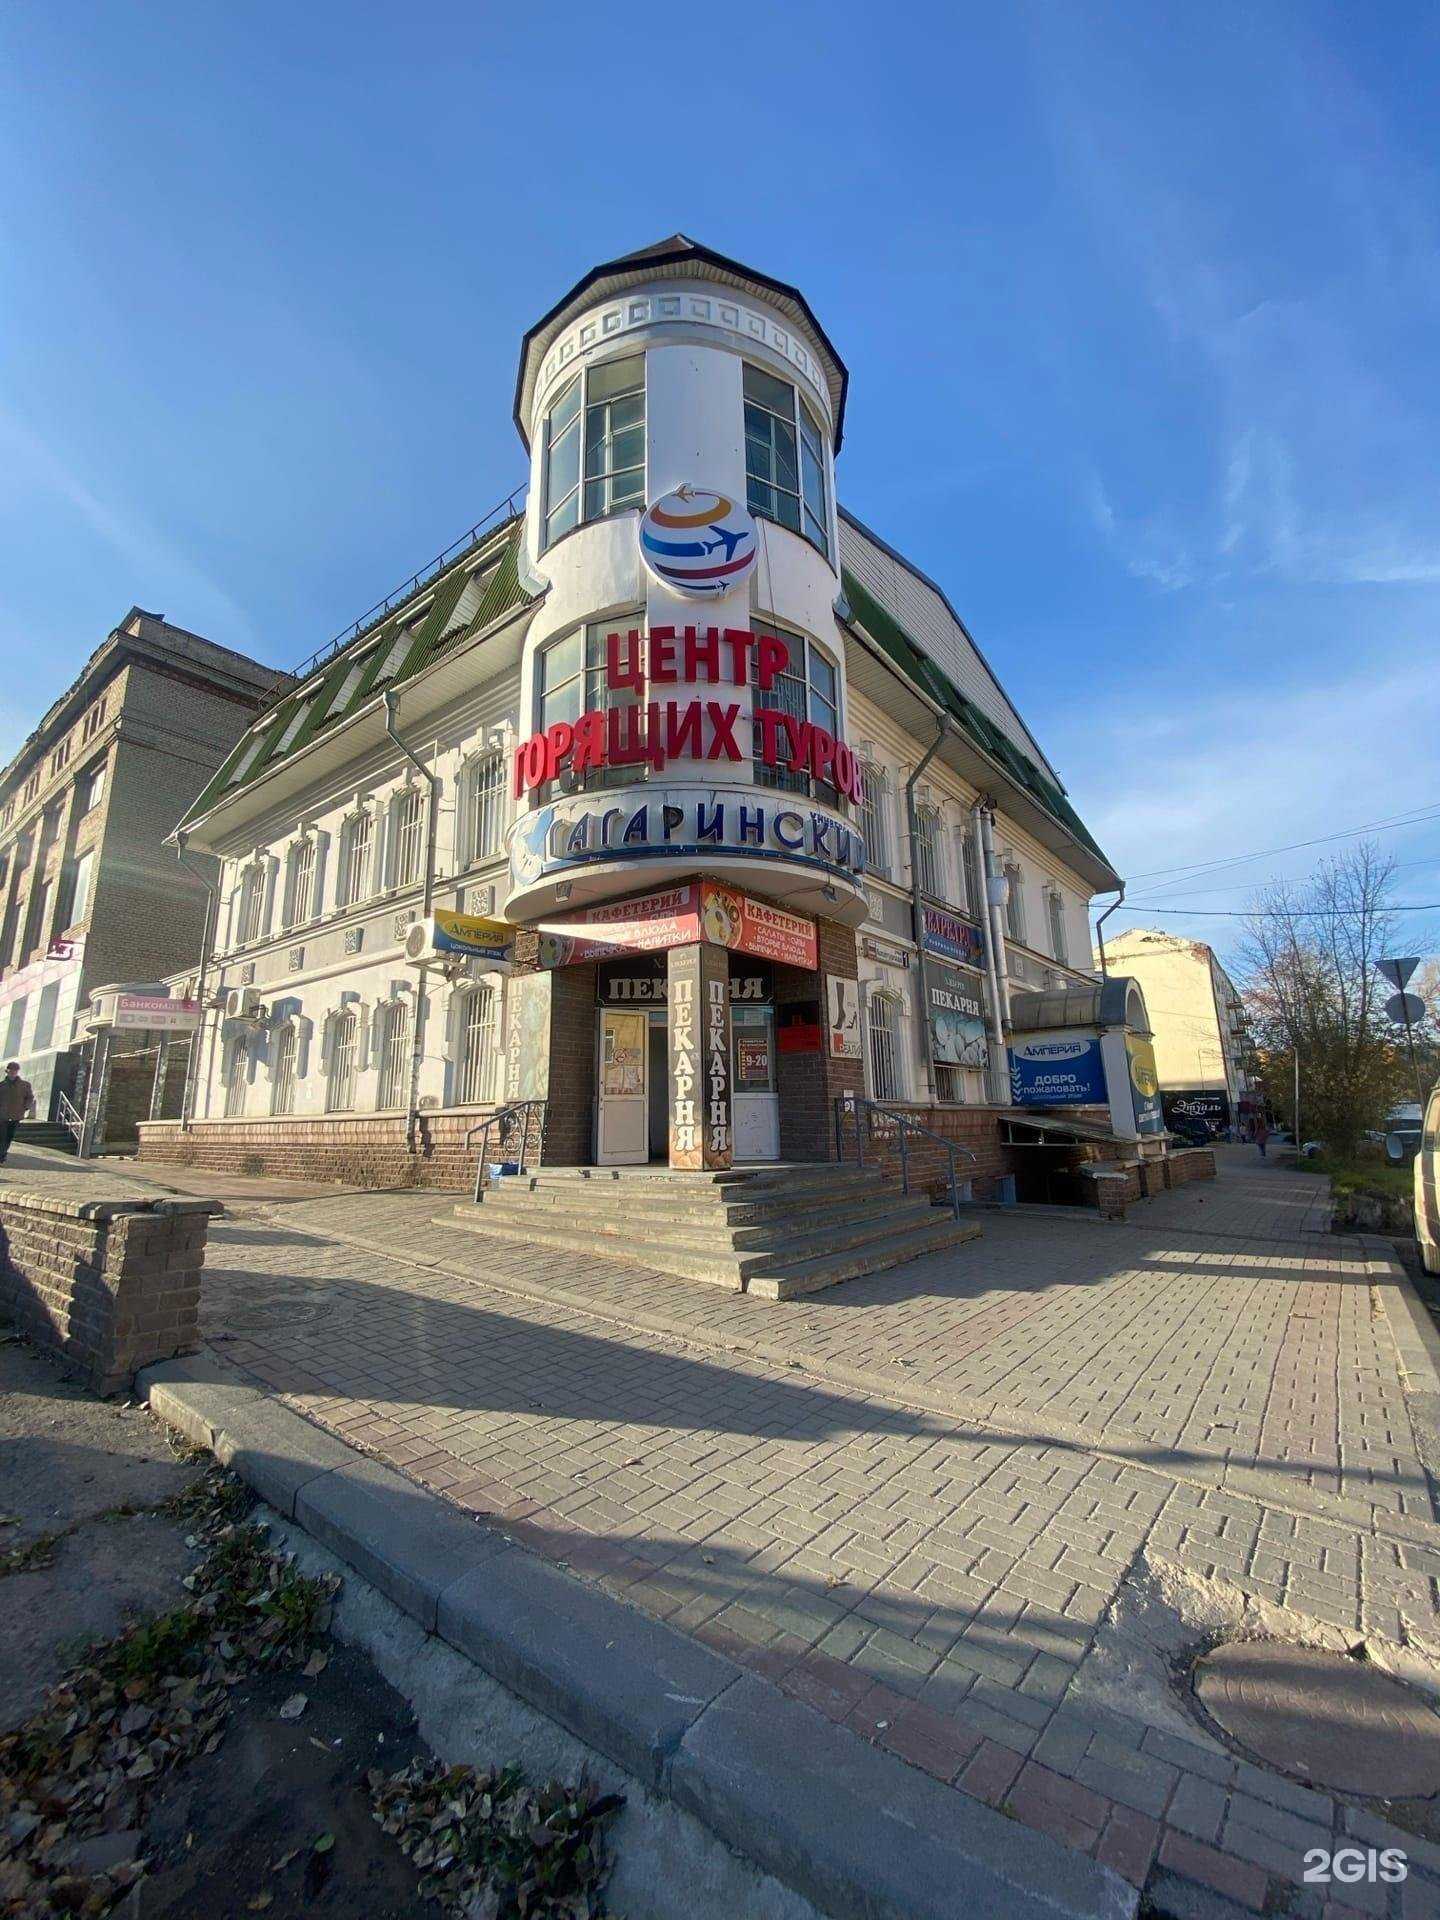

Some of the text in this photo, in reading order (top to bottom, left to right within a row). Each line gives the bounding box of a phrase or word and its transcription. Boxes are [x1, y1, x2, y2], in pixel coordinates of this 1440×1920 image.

[606, 625, 790, 696] ЦЕНТР
[513, 700, 864, 806] ГОРЯЩИХ ТУРОВ
[592, 888, 684, 923] КАФЕТЕРИЙ
[747, 902, 813, 937] КАФЕТЕРИЙ
[608, 977, 764, 999] ПЕКНЯ
[931, 987, 980, 1017] ПЕКАРНЯ
[673, 979, 695, 1151] ПЕКАРНЯ
[708, 980, 728, 1151] ПЕКАРНЯ
[746, 1054, 768, 1066] 9-20
[1023, 1082, 1091, 1095] пожаловать!
[1034, 1073, 1077, 1087] ДОБРО
